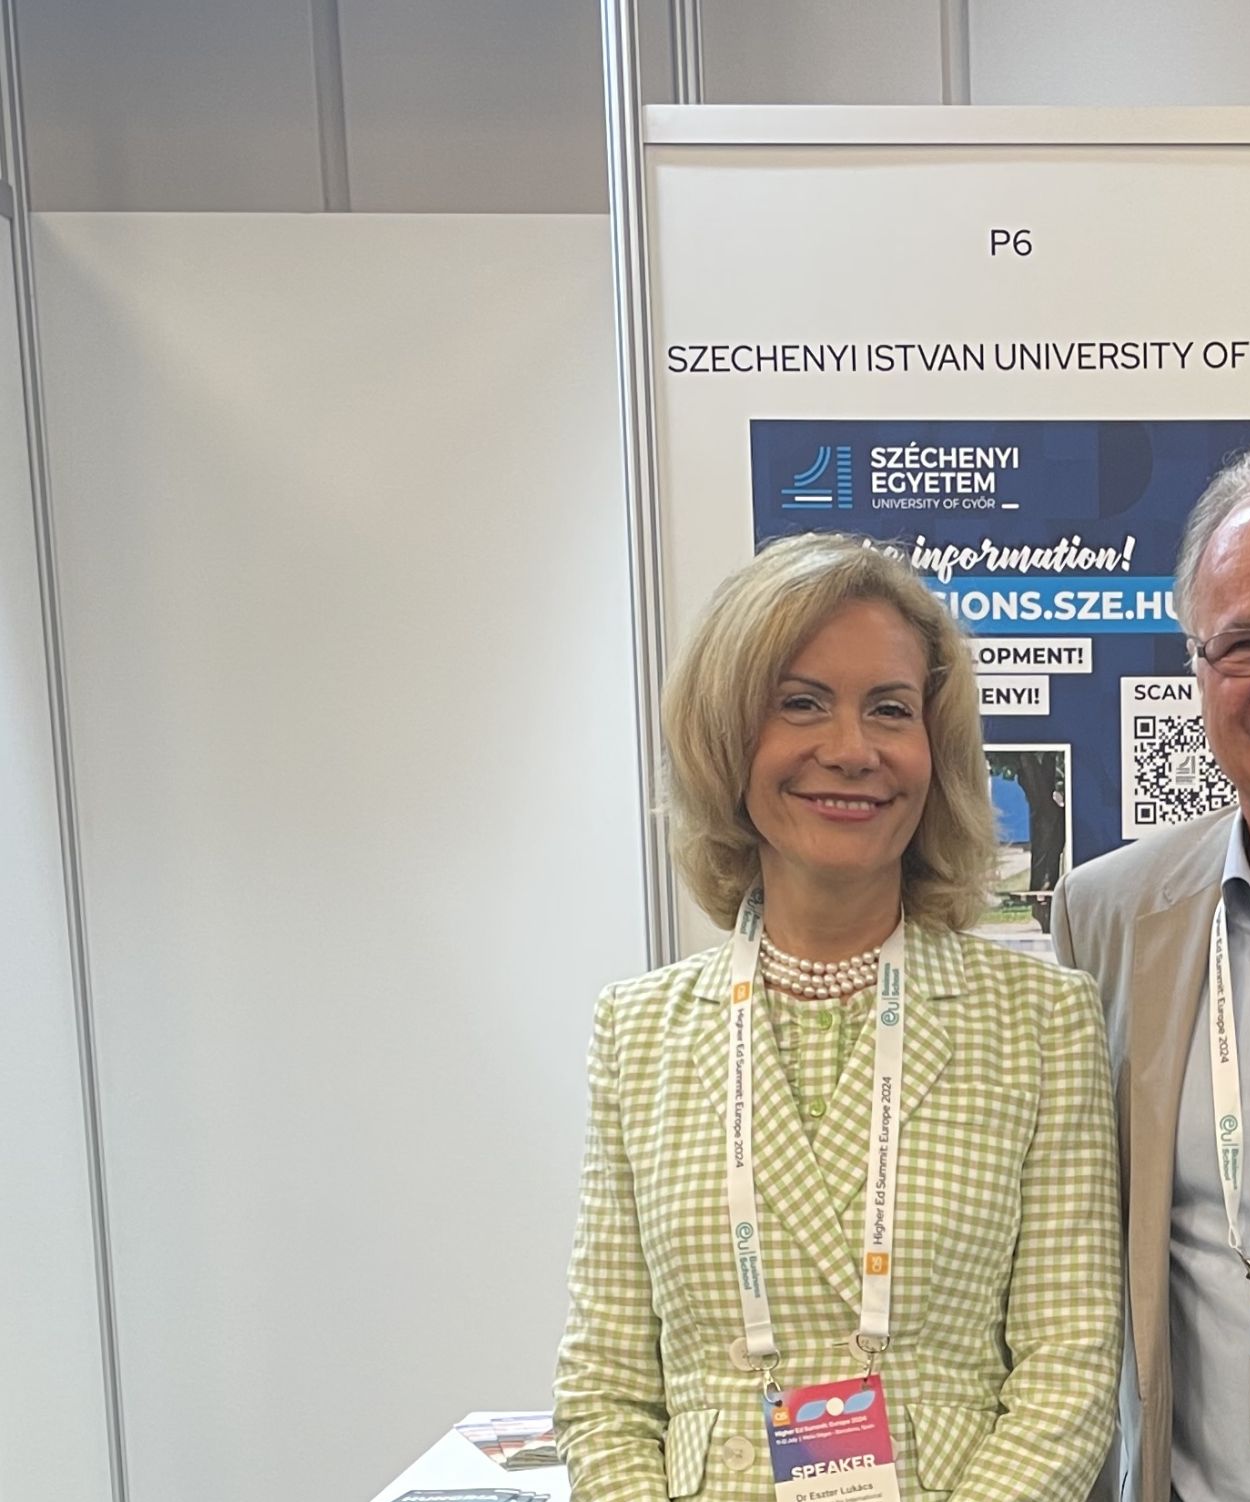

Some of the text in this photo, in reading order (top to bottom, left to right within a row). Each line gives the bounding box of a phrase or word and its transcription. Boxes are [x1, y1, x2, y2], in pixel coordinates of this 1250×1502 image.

[990, 229, 1032, 257] P6
[667, 345, 857, 374] SZECHENYI
[866, 344, 985, 372] ISTVAN
[995, 341, 1193, 371] UNIVERSITY
[1203, 341, 1248, 370] OF
[870, 441, 1020, 469] SZÉCHENYI
[871, 472, 996, 494] EGYETEM
[872, 495, 996, 510] UNIVERSITY OF GYŐR
[911, 535, 1136, 584] information!
[1134, 684, 1192, 700] SCAN
[1215, 953, 1224, 994] Summit
[1215, 996, 1226, 1034] Europe
[1218, 1036, 1229, 1064] 2024
[735, 1059, 745, 1100] Summit
[734, 1101, 745, 1138] Europe
[734, 1140, 745, 1168] 2024
[873, 1076, 892, 1245] Higher Ed Summit Europe 2024
[791, 1454, 875, 1480] SPEAKER
[796, 1494, 807, 1502] Dr
[809, 1489, 838, 1500] Eszter
